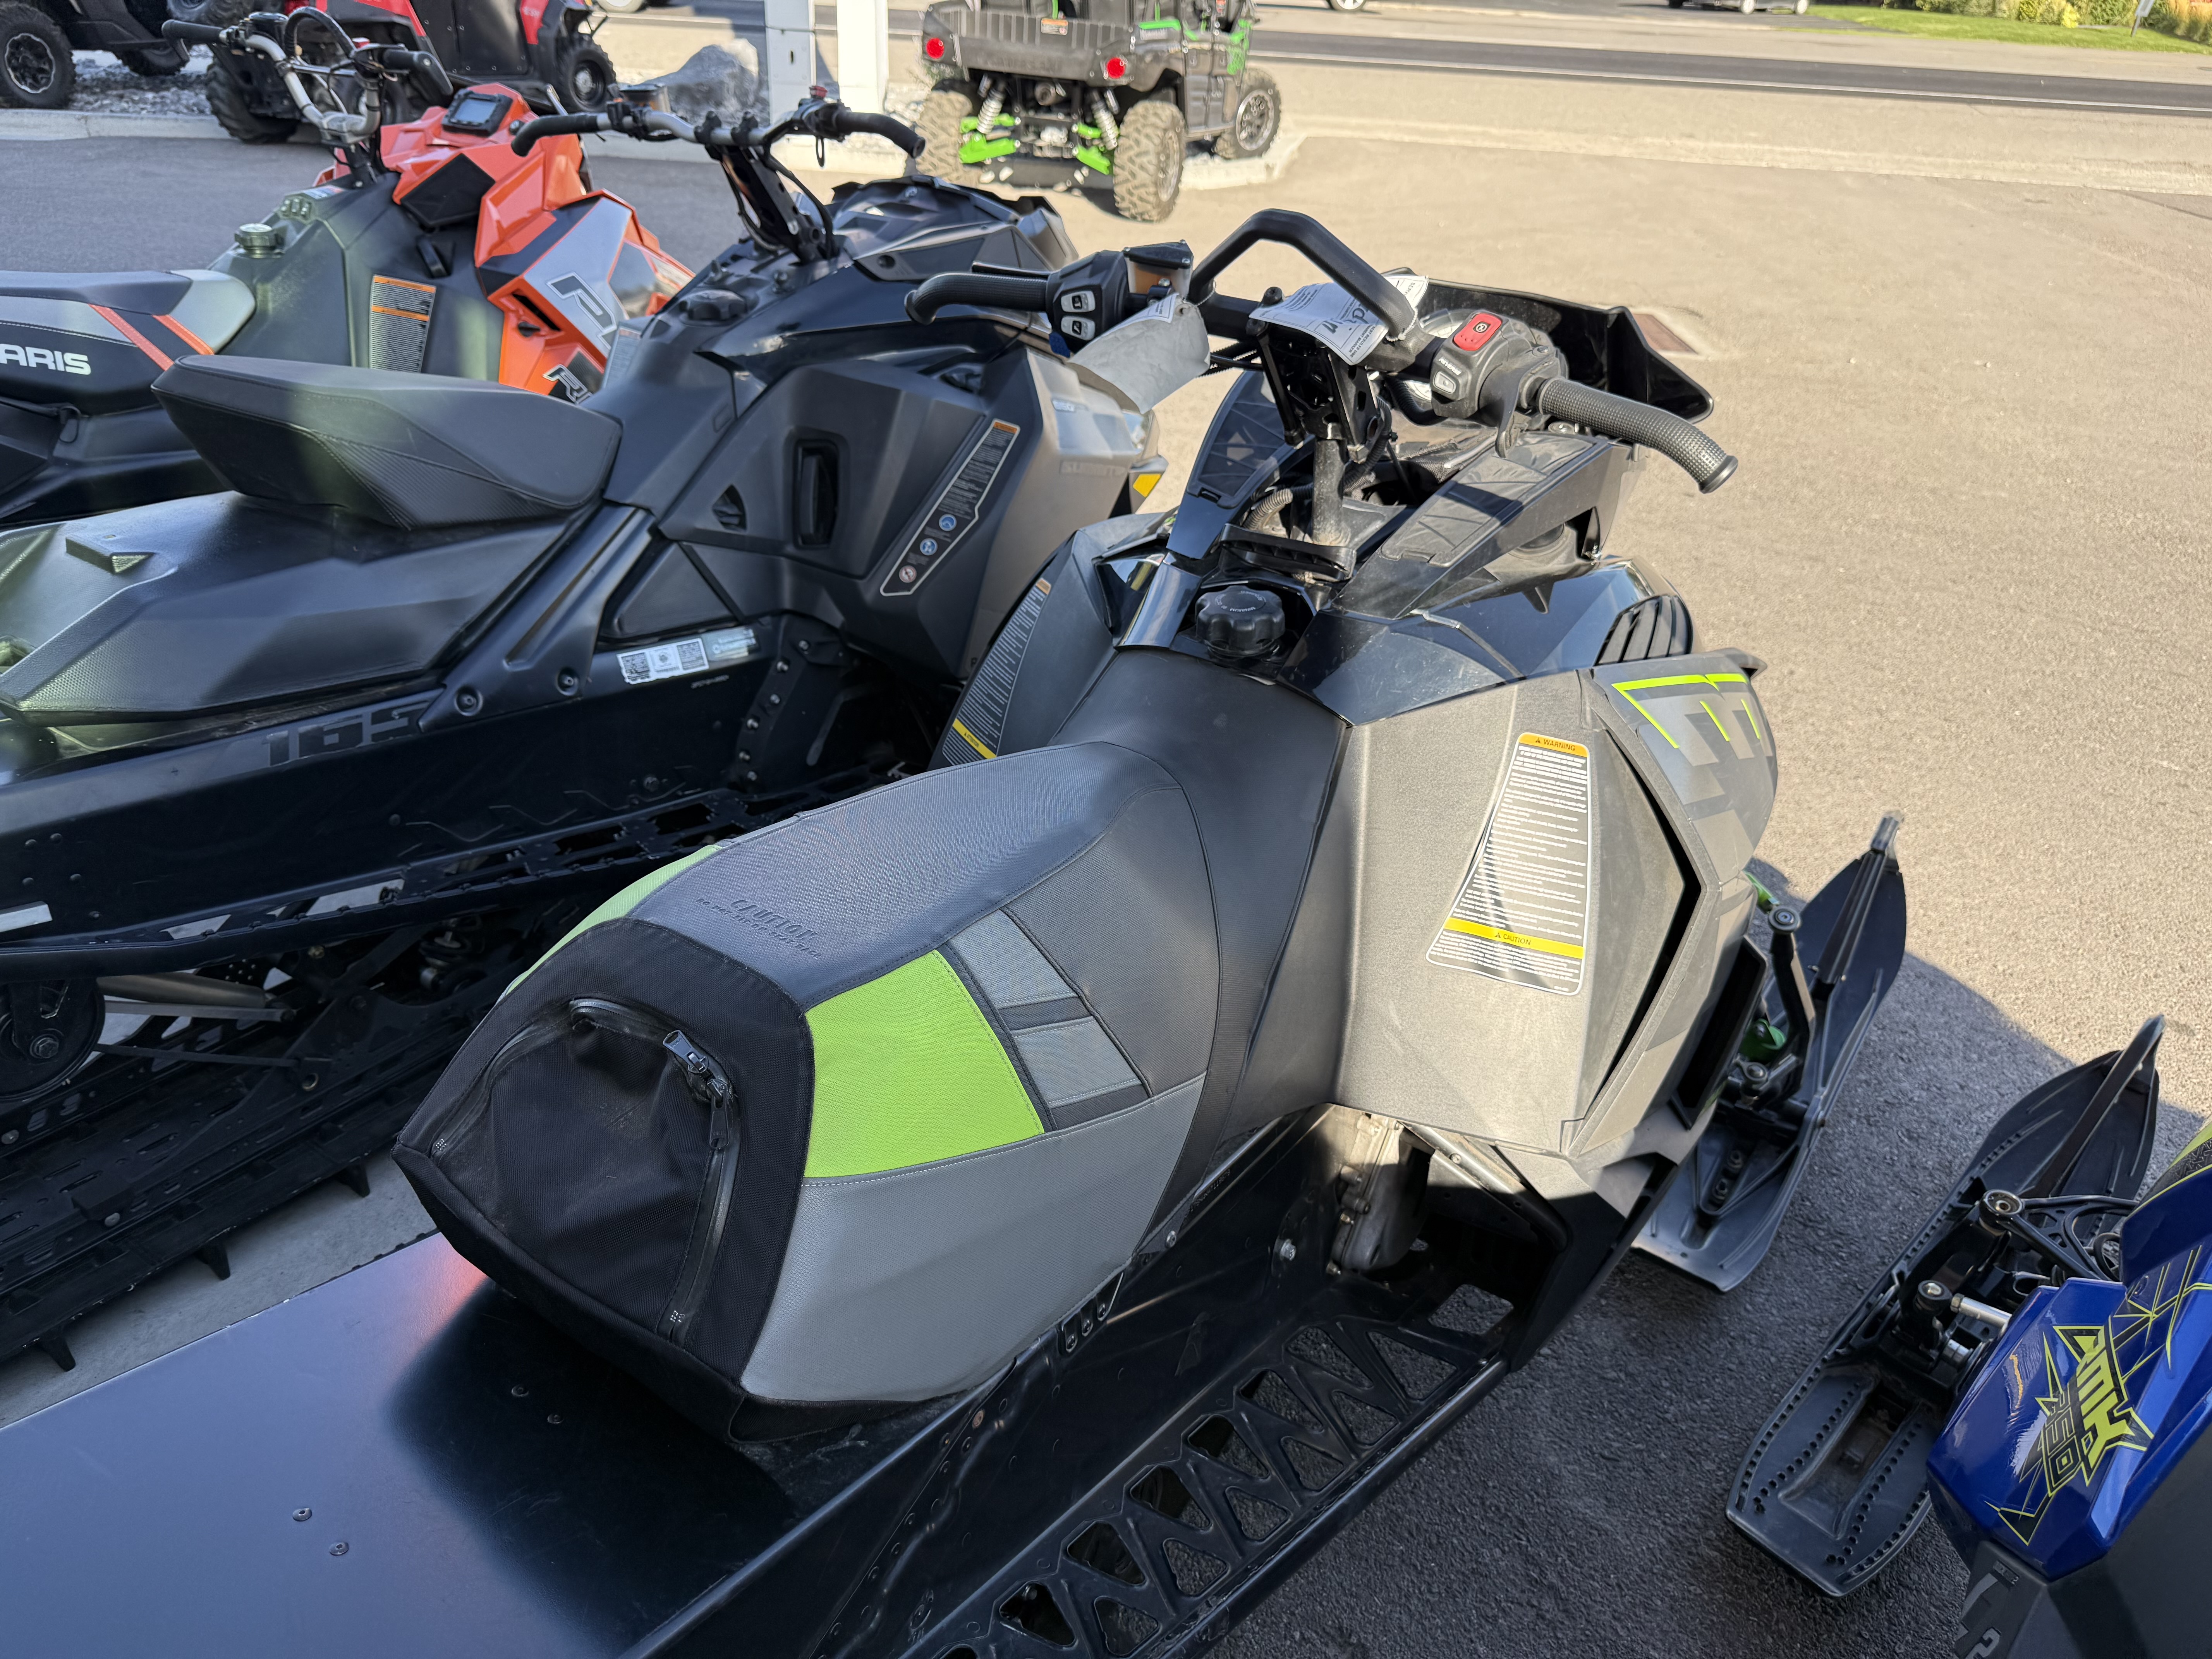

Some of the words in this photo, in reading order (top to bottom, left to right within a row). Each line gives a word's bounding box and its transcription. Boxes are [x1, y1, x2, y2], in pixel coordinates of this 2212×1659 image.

[545, 271, 617, 350] P
[1348, 337, 1362, 353] MARKER
[1356, 334, 1370, 350] RESULTS
[1350, 350, 1358, 358] USE
[1438, 357, 1462, 376] REVERSE
[1543, 738, 1576, 751] WARNING
[730, 899, 819, 942] CAUTION
[711, 905, 732, 915] NOT
[733, 915, 751, 924] SIT
[768, 932, 795, 944] SEAT
[794, 944, 823, 959] BACK
[1503, 933, 1532, 945] CAUTION
[2068, 1326, 2135, 1472] RMK
